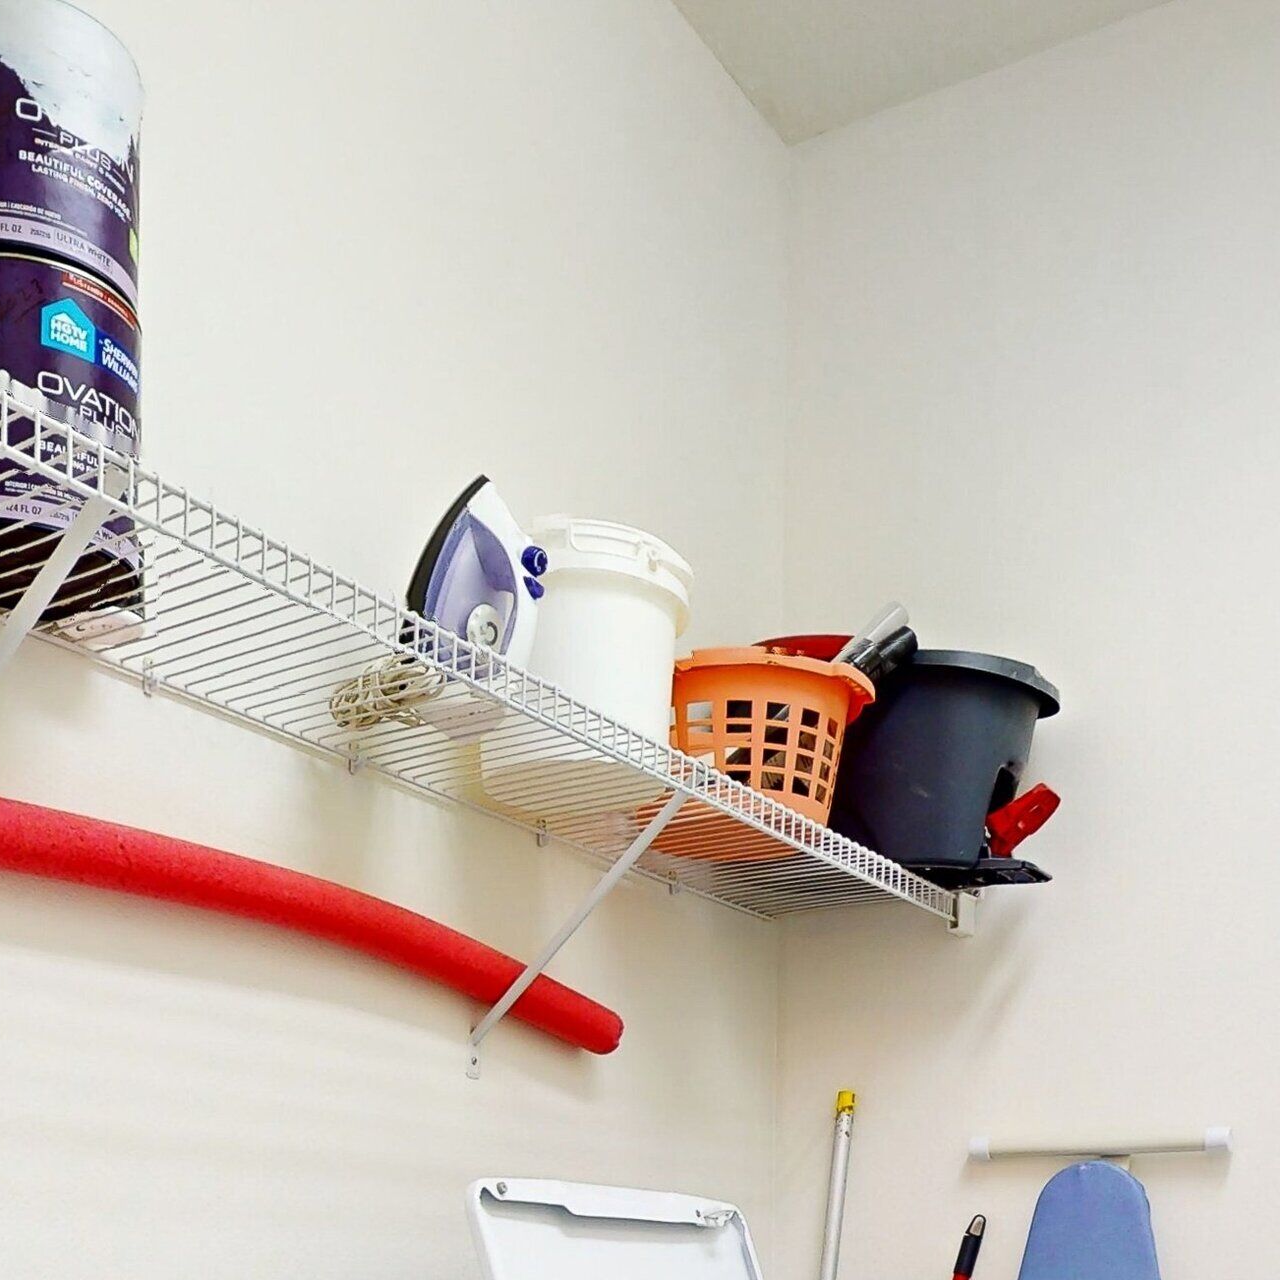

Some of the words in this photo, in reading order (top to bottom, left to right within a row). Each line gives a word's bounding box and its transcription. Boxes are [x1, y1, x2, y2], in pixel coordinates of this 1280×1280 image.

[18, 149, 85, 181] BEAUTIFUL
[31, 164, 69, 184] LASTING
[0, 223, 10, 232] FL
[12, 224, 22, 234] OZ
[56, 232, 85, 250] ULTRA
[88, 246, 111, 267] WHITE
[51, 318, 88, 340] HGTV
[51, 329, 88, 352] HOME
[37, 370, 141, 441] OVATION
